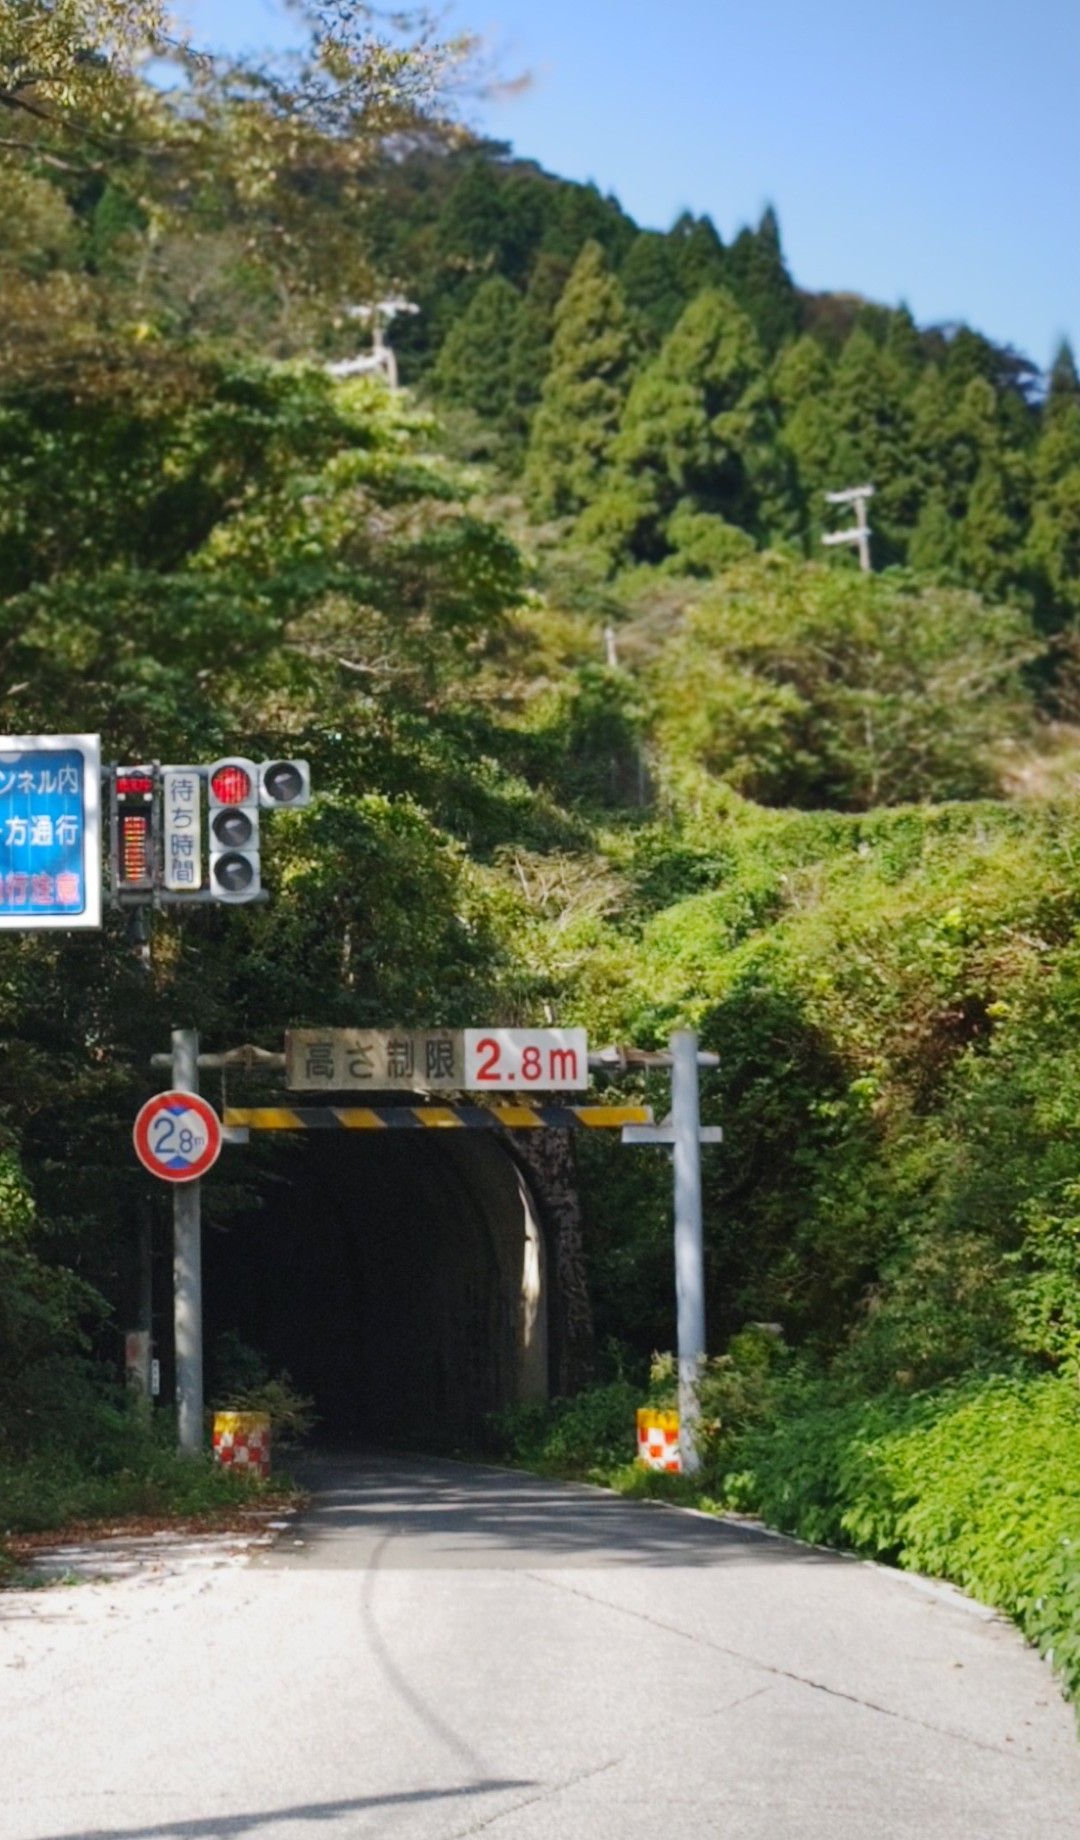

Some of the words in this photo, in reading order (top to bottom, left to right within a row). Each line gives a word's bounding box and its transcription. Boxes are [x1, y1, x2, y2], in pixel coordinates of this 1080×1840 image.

[171, 779, 194, 883] 待ち時間
[305, 1040, 455, 1080] 高さ制限
[475, 1038, 578, 1082] 2.8m
